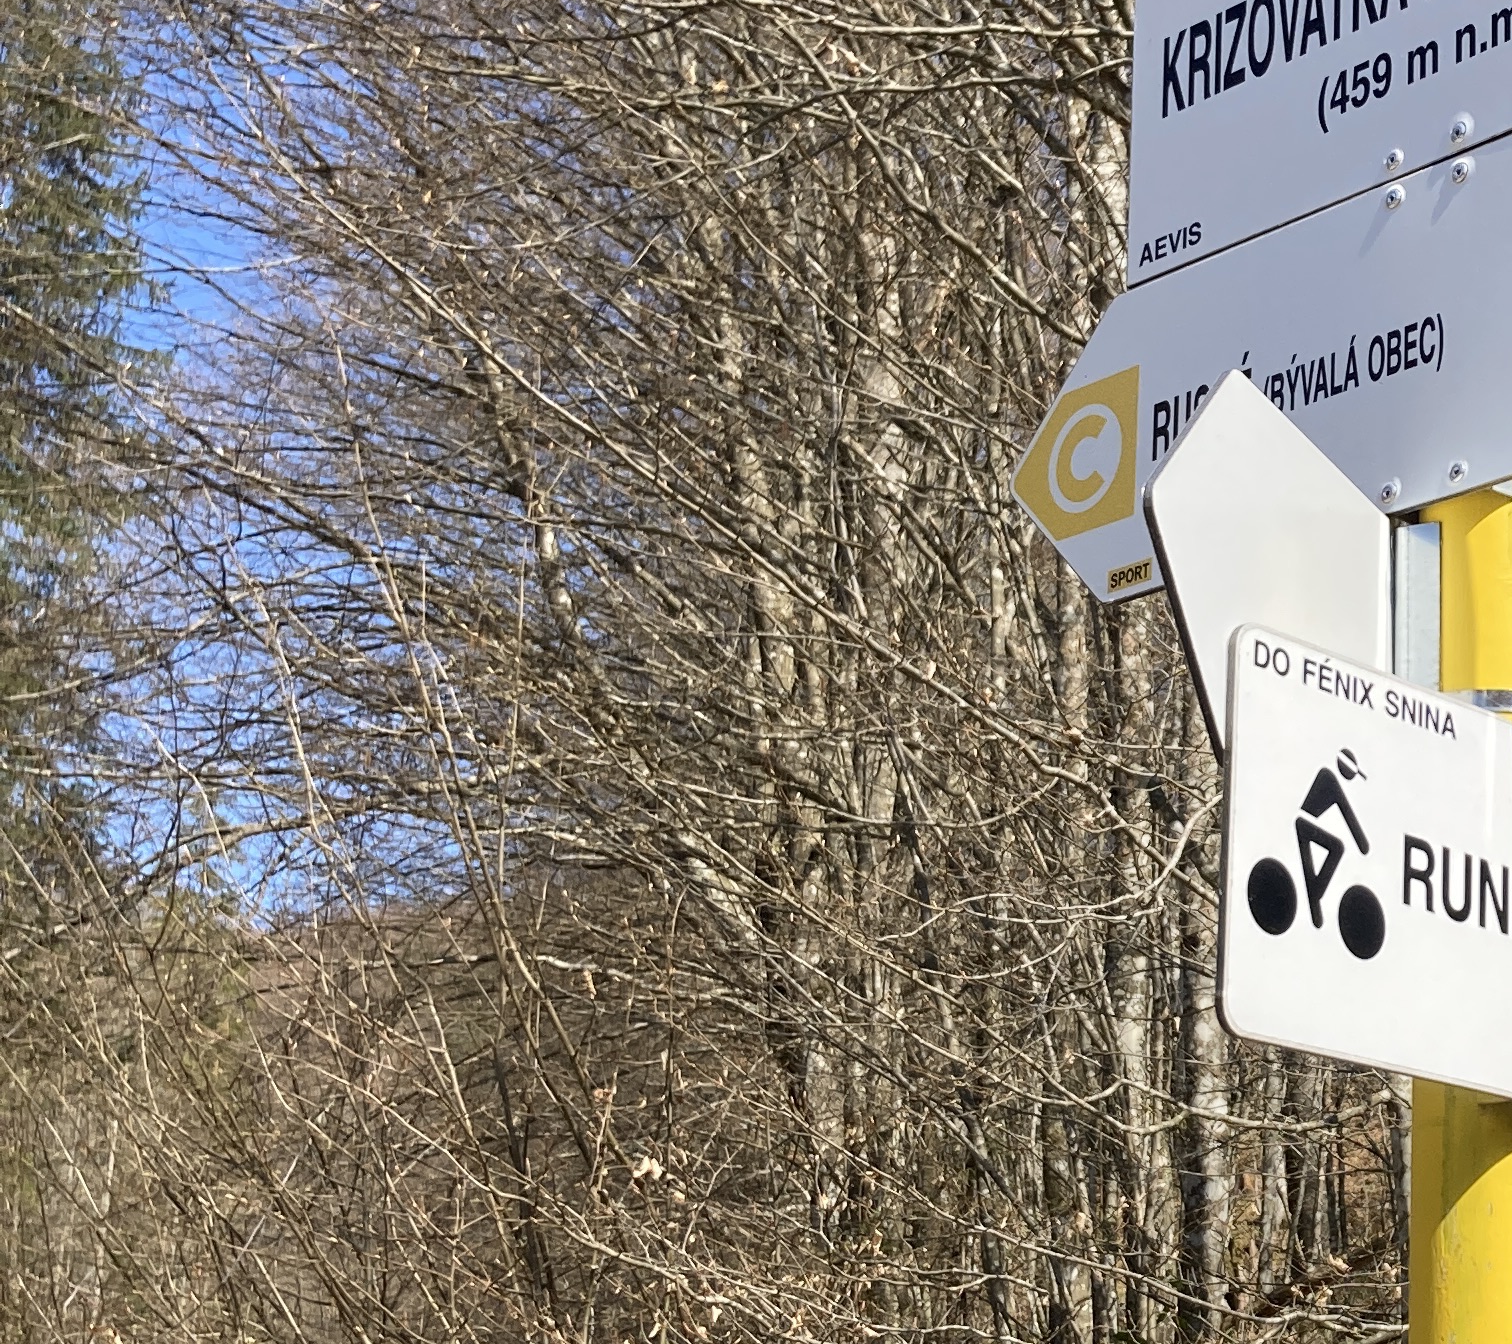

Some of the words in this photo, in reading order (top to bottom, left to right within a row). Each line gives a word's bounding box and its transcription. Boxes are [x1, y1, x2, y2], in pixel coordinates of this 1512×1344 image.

[1317, 55, 1393, 133] (459
[1406, 36, 1440, 86] m
[1138, 221, 1202, 267] AEVIS
[1367, 313, 1445, 383] OBEC)
[1110, 562, 1150, 589] SPORT
[1253, 639, 1290, 676] DO
[1302, 657, 1375, 710] FÉNIX
[1385, 690, 1458, 741] SNINA
